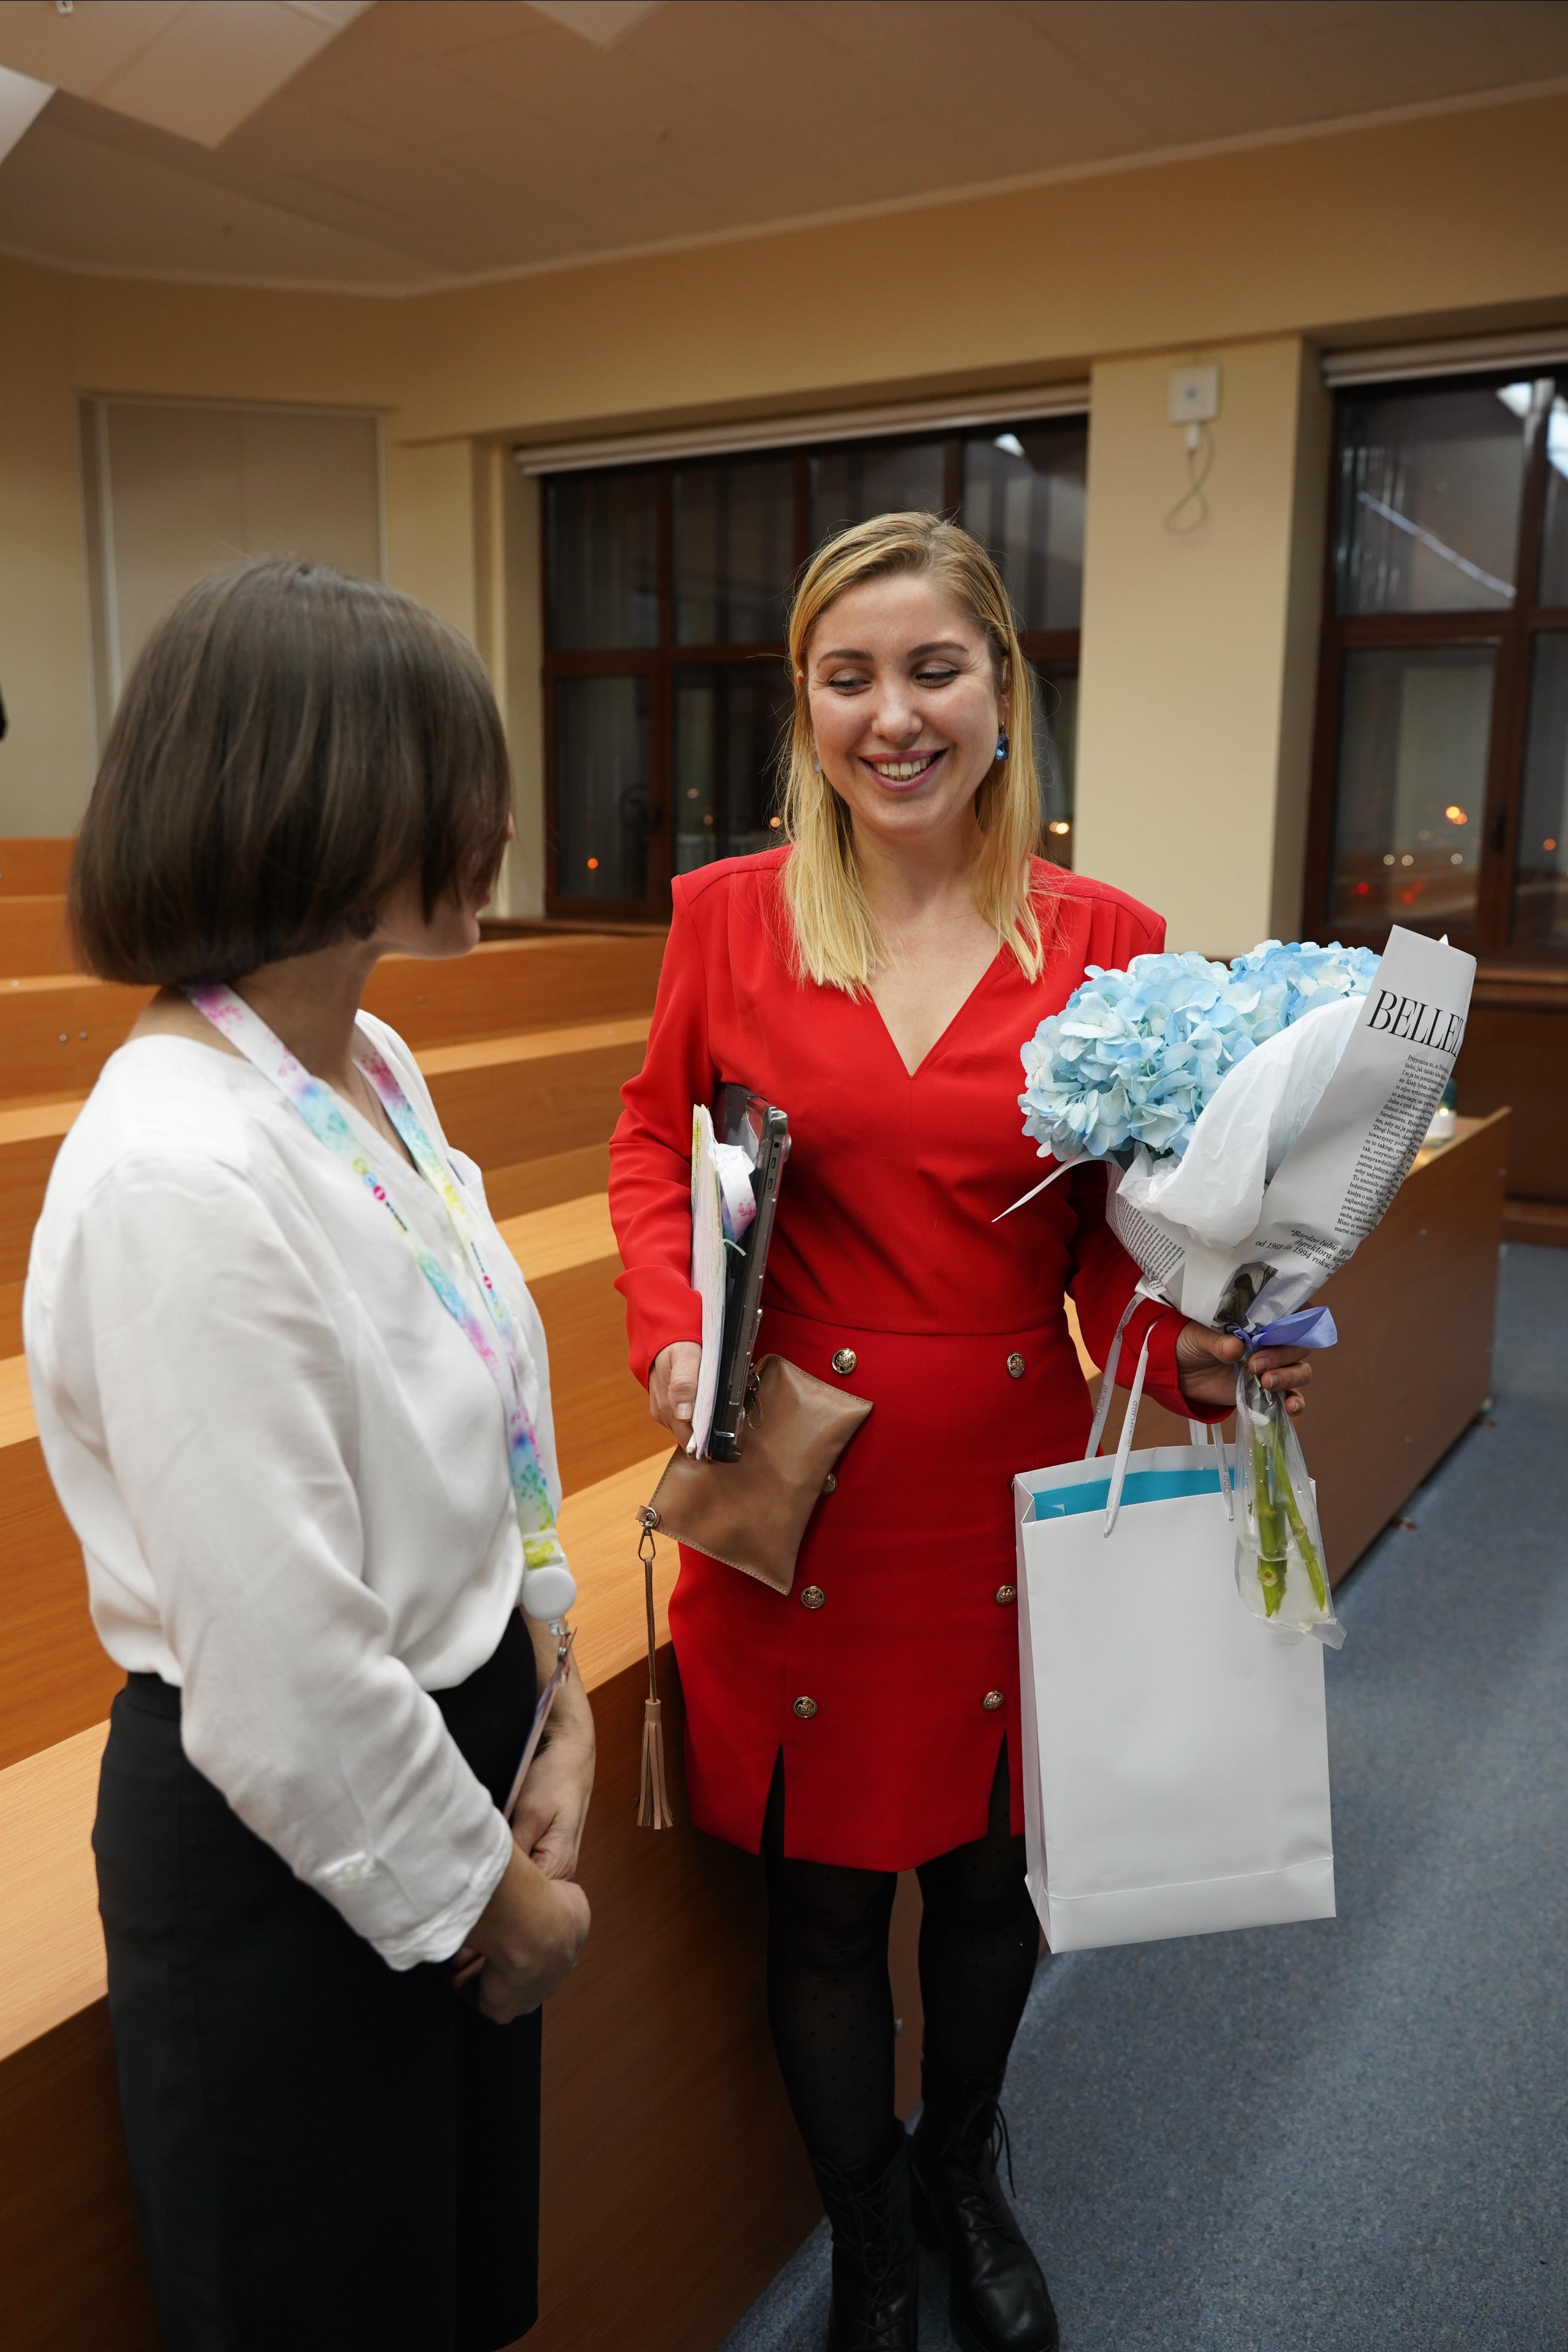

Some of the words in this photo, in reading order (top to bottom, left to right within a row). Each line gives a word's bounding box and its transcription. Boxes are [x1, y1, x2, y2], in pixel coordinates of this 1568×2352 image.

[1408, 1055, 1428, 1066] Przypomina
[1406, 1079, 1417, 1088] Kiedy
[1399, 1109, 1414, 1118] zawsze
[1368, 1131, 1394, 1144] towarzyszy
[1387, 1128, 1401, 1139] Ivanie,
[1378, 1143, 1395, 1153] takiego,
[1356, 1160, 1373, 1169] jestem
[1372, 1166, 1389, 1175] jednym
[1360, 1178, 1379, 1188] zmienilo
[1347, 1189, 1361, 1198] kiedys
[1344, 1197, 1370, 1209] najbardziej
[1340, 1212, 1352, 1221] osoba,
[1341, 1205, 1368, 1217] powtarzalny,
[1337, 1218, 1350, 1226] Mimo
[1291, 1230, 1319, 1246] “Bardzo
[1294, 1237, 1332, 1259] dyrektora
[1292, 1245, 1312, 1259] 1994
[1312, 1257, 1333, 1270] roku:
